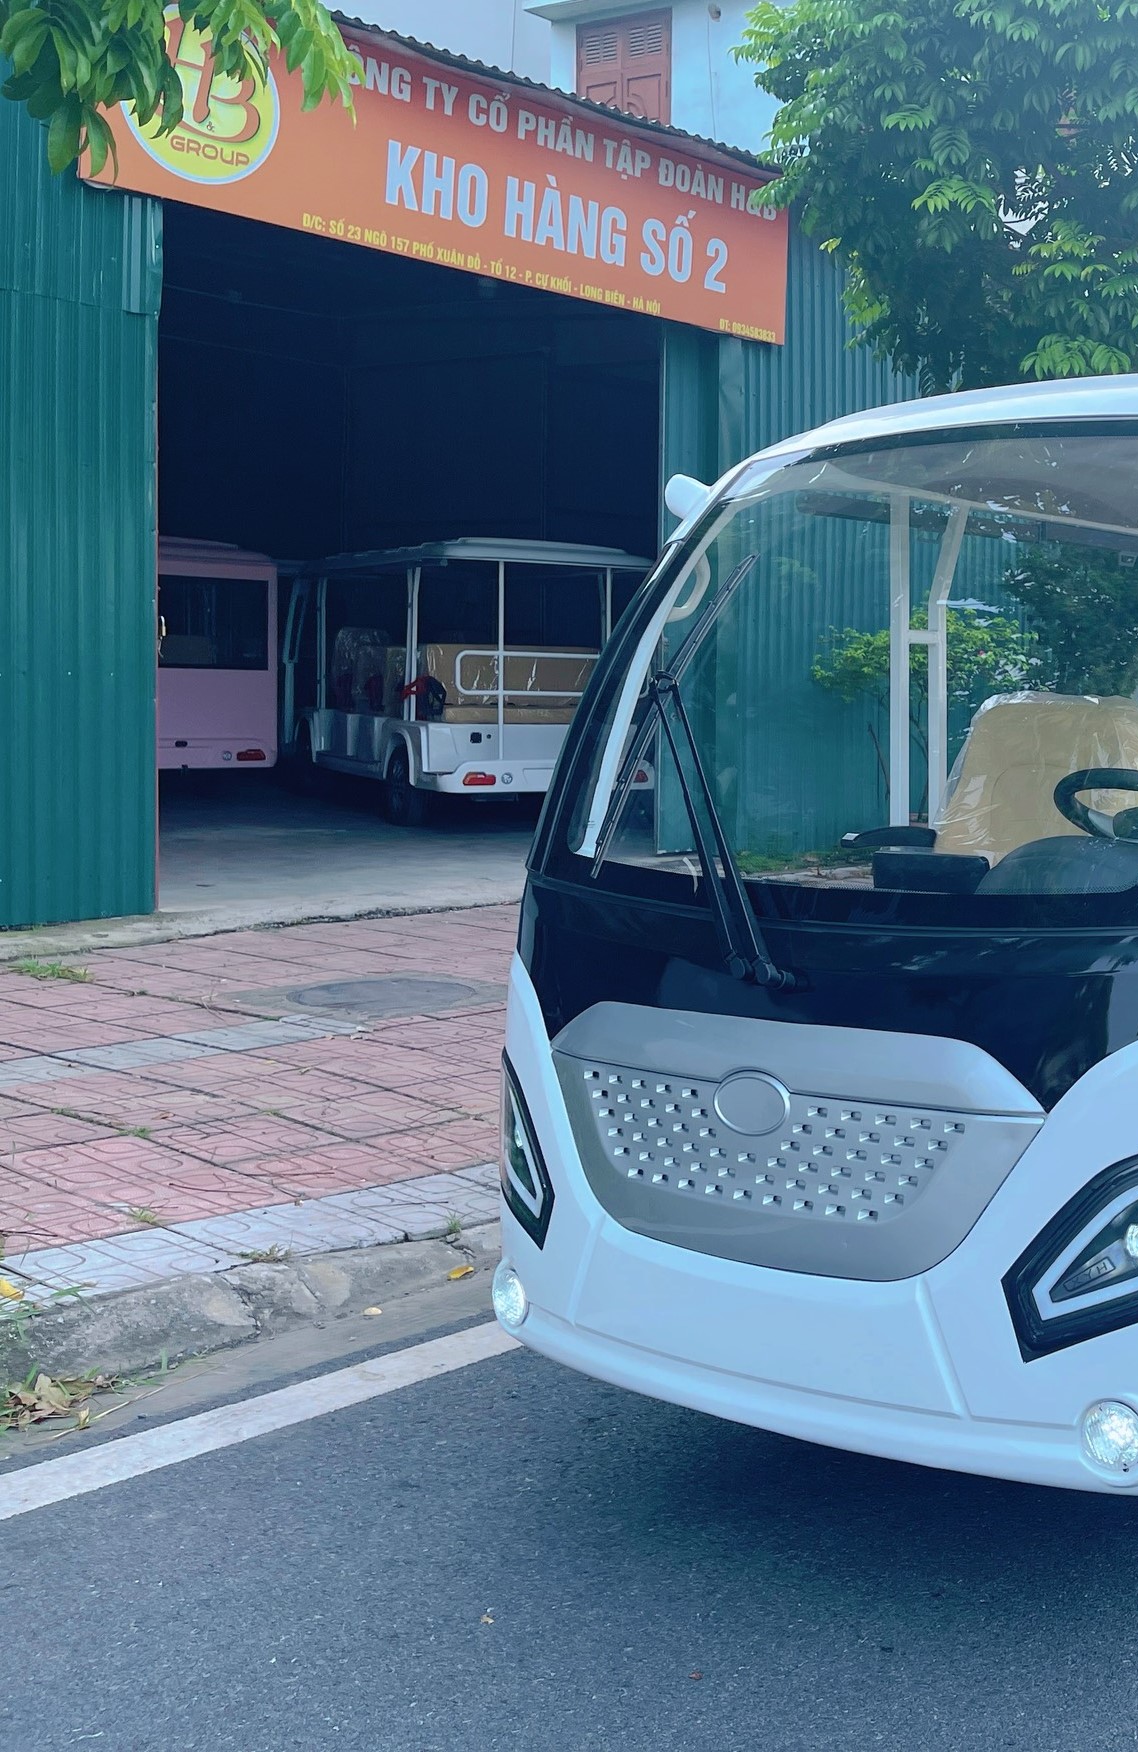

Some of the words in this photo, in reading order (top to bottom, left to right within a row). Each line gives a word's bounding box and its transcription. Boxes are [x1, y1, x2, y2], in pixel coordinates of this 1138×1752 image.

[170, 134, 250, 167] GROUP
[347, 44, 412, 103] ÔNG
[422, 76, 459, 117] TY
[468, 92, 511, 134] CỔ
[517, 109, 594, 163] PHẦN
[603, 137, 651, 180] TẬP
[658, 157, 724, 204] ĐOÀN
[329, 217, 346, 237] SỐ
[347, 225, 361, 241] 23
[390, 236, 410, 253] 157
[412, 241, 434, 259] PHỐ
[436, 246, 465, 267] XUÂN
[505, 265, 517, 280] 12
[550, 275, 572, 293] KHỐI
[580, 283, 603, 299] LONG
[604, 289, 625, 306] BIÊN
[632, 295, 645, 311] HÀ
[646, 300, 661, 317] NỘI
[386, 139, 489, 228] KHO
[504, 174, 628, 267] HÀNG
[640, 210, 698, 284] SỐ
[704, 238, 729, 294] 2
